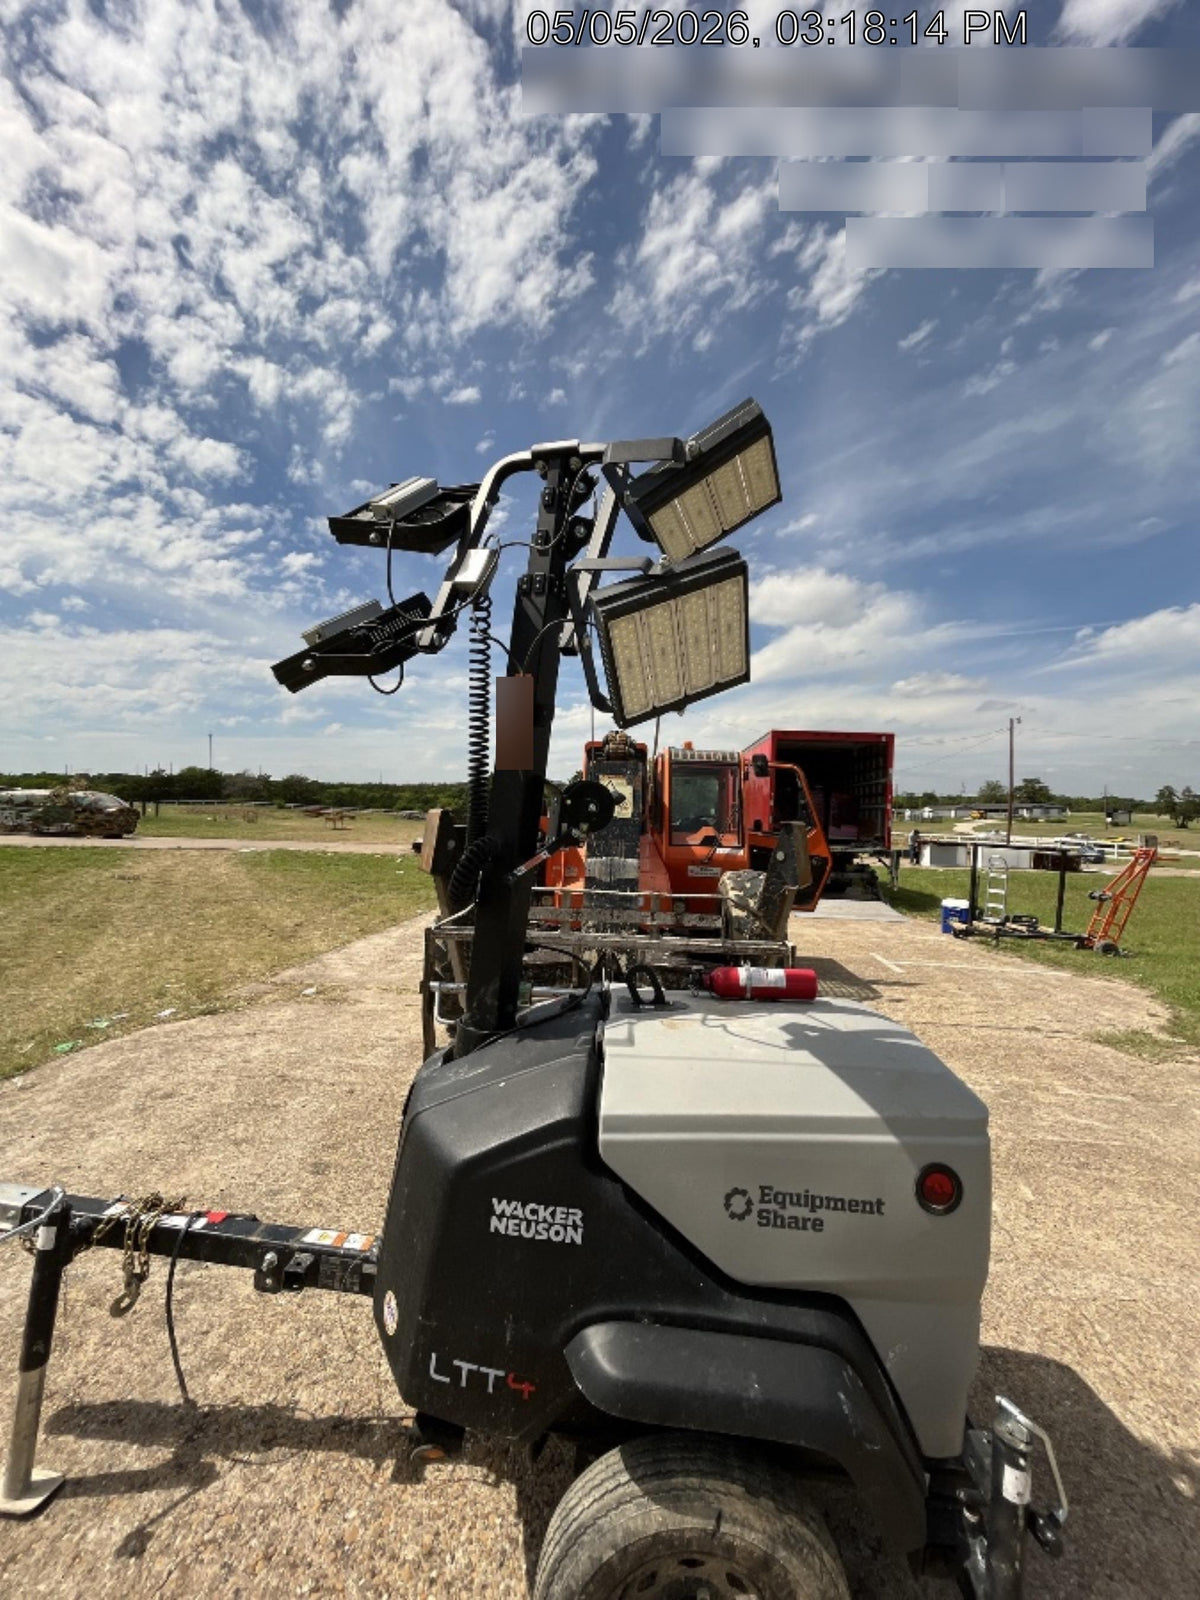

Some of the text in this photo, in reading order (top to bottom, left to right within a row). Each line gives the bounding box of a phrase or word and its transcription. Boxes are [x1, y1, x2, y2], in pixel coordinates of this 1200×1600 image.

[491, 1197, 584, 1228] WACKER
[758, 1185, 886, 1215] Equipment
[489, 1215, 584, 1245] NEUSON
[757, 1208, 824, 1233] Share
[429, 1352, 536, 1400] LTT4
